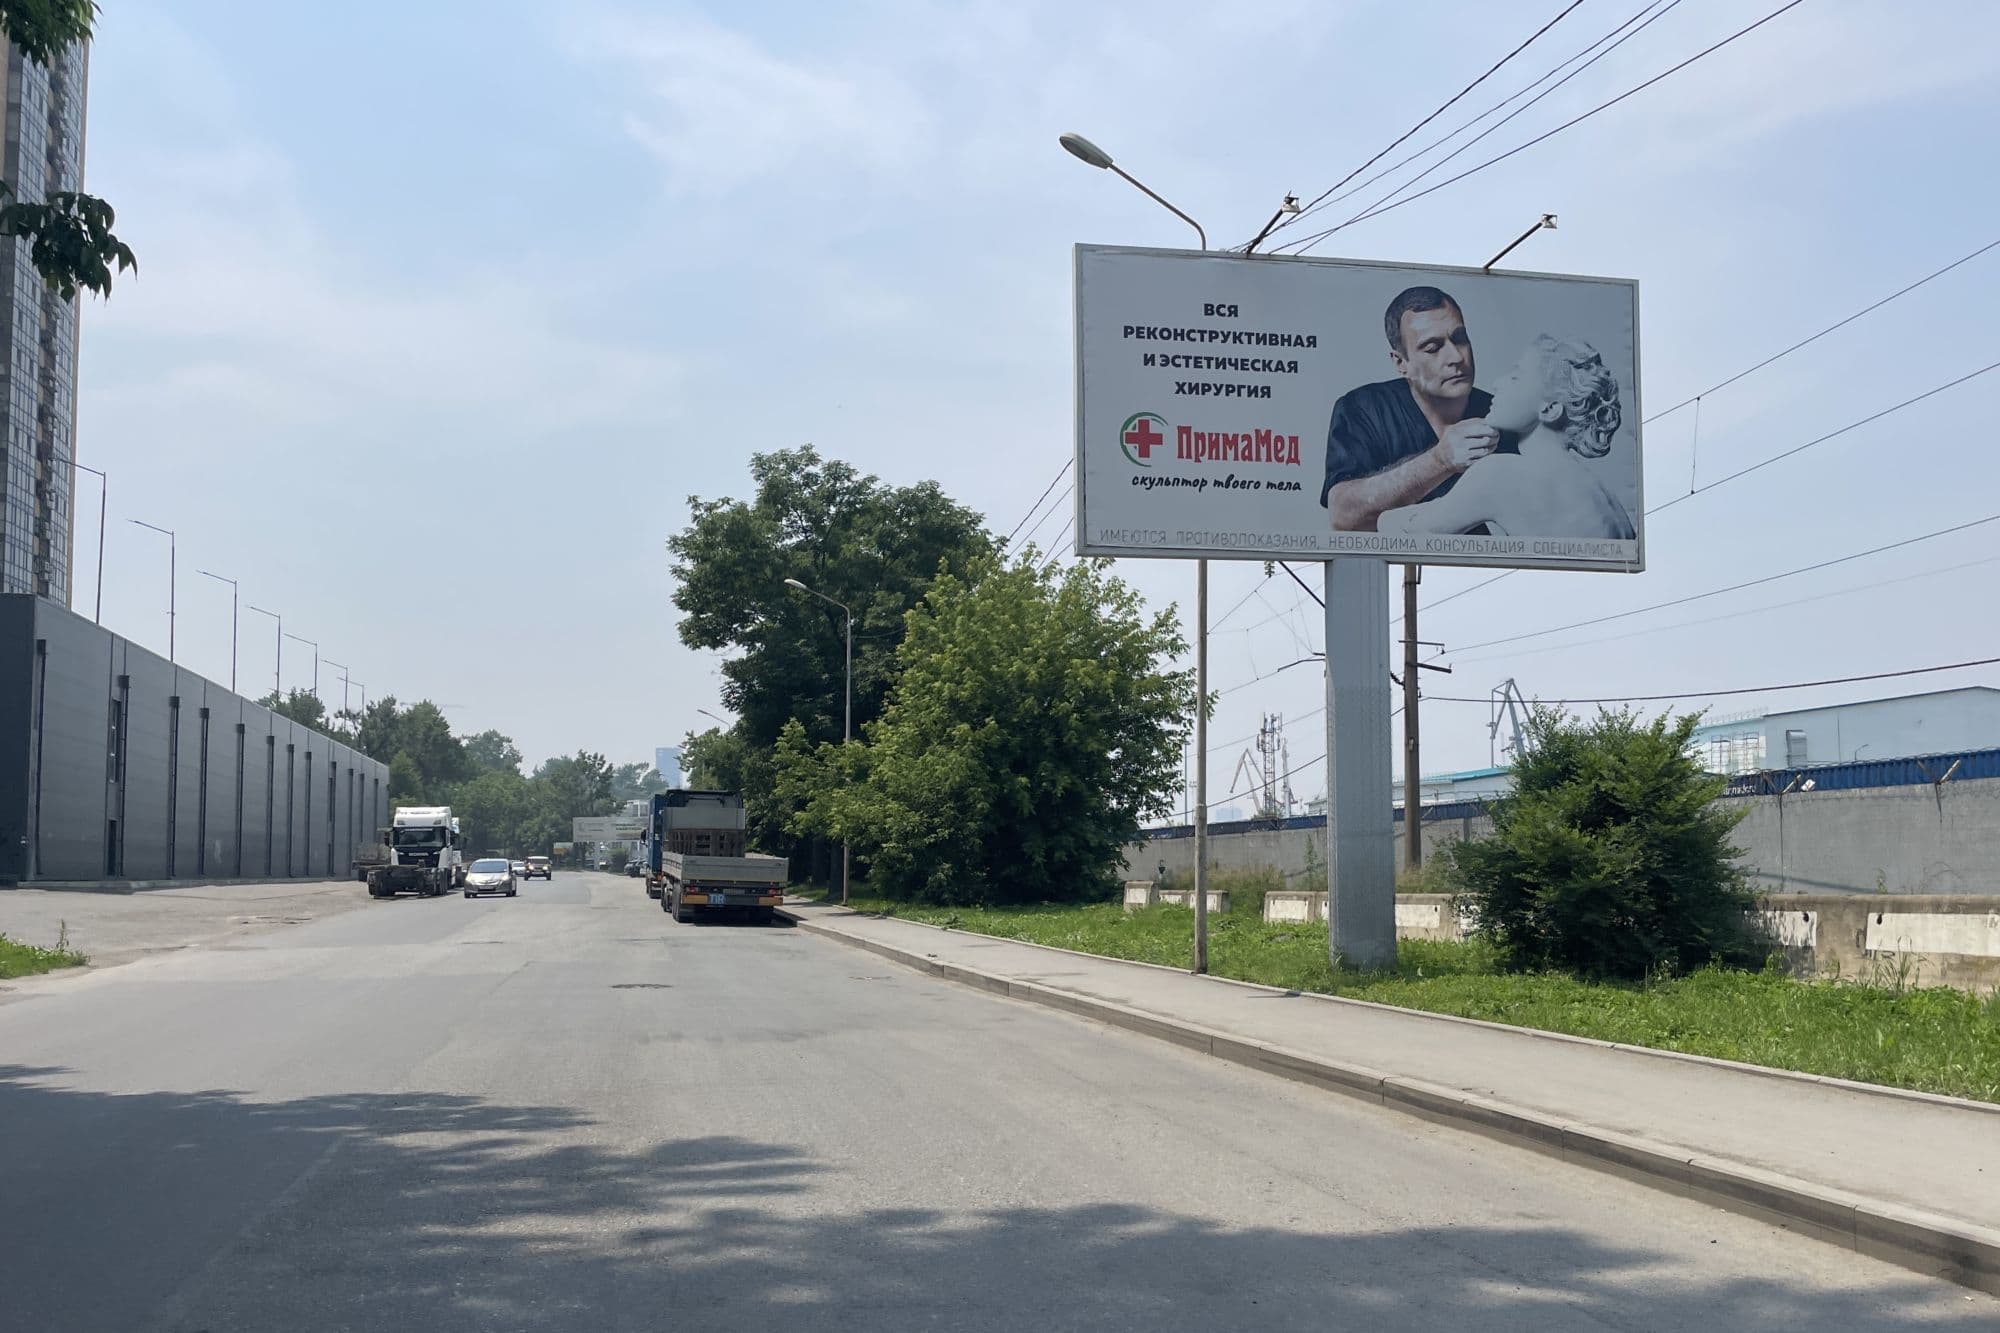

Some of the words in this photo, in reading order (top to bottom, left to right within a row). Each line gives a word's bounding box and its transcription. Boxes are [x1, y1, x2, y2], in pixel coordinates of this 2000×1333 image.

[1203, 303, 1239, 318] ВСЯ
[1123, 325, 1317, 348] РЕКОНСТРУКТИВНАЯ
[1143, 353, 1156, 367] И
[1159, 354, 1299, 374] ЭСТЕТИЧЕСКАЯ
[1174, 381, 1272, 399] ХИРУРГИЯ
[1177, 425, 1301, 466] ПримаМед
[1131, 475, 1208, 493] скульптор
[1213, 474, 1261, 491] твоего
[1266, 480, 1302, 492] тела
[1099, 529, 1167, 544] ИМЕЮТСЯ
[1176, 530, 1320, 549] ПРОТИВОПОКАЗАНИЯ,
[1329, 536, 1417, 551] НЕОБХОДИМА
[1426, 538, 1525, 554] КОНСУЛЬТАЦИЯ
[1533, 541, 1624, 557] СПЕЦИАЛИСТА
